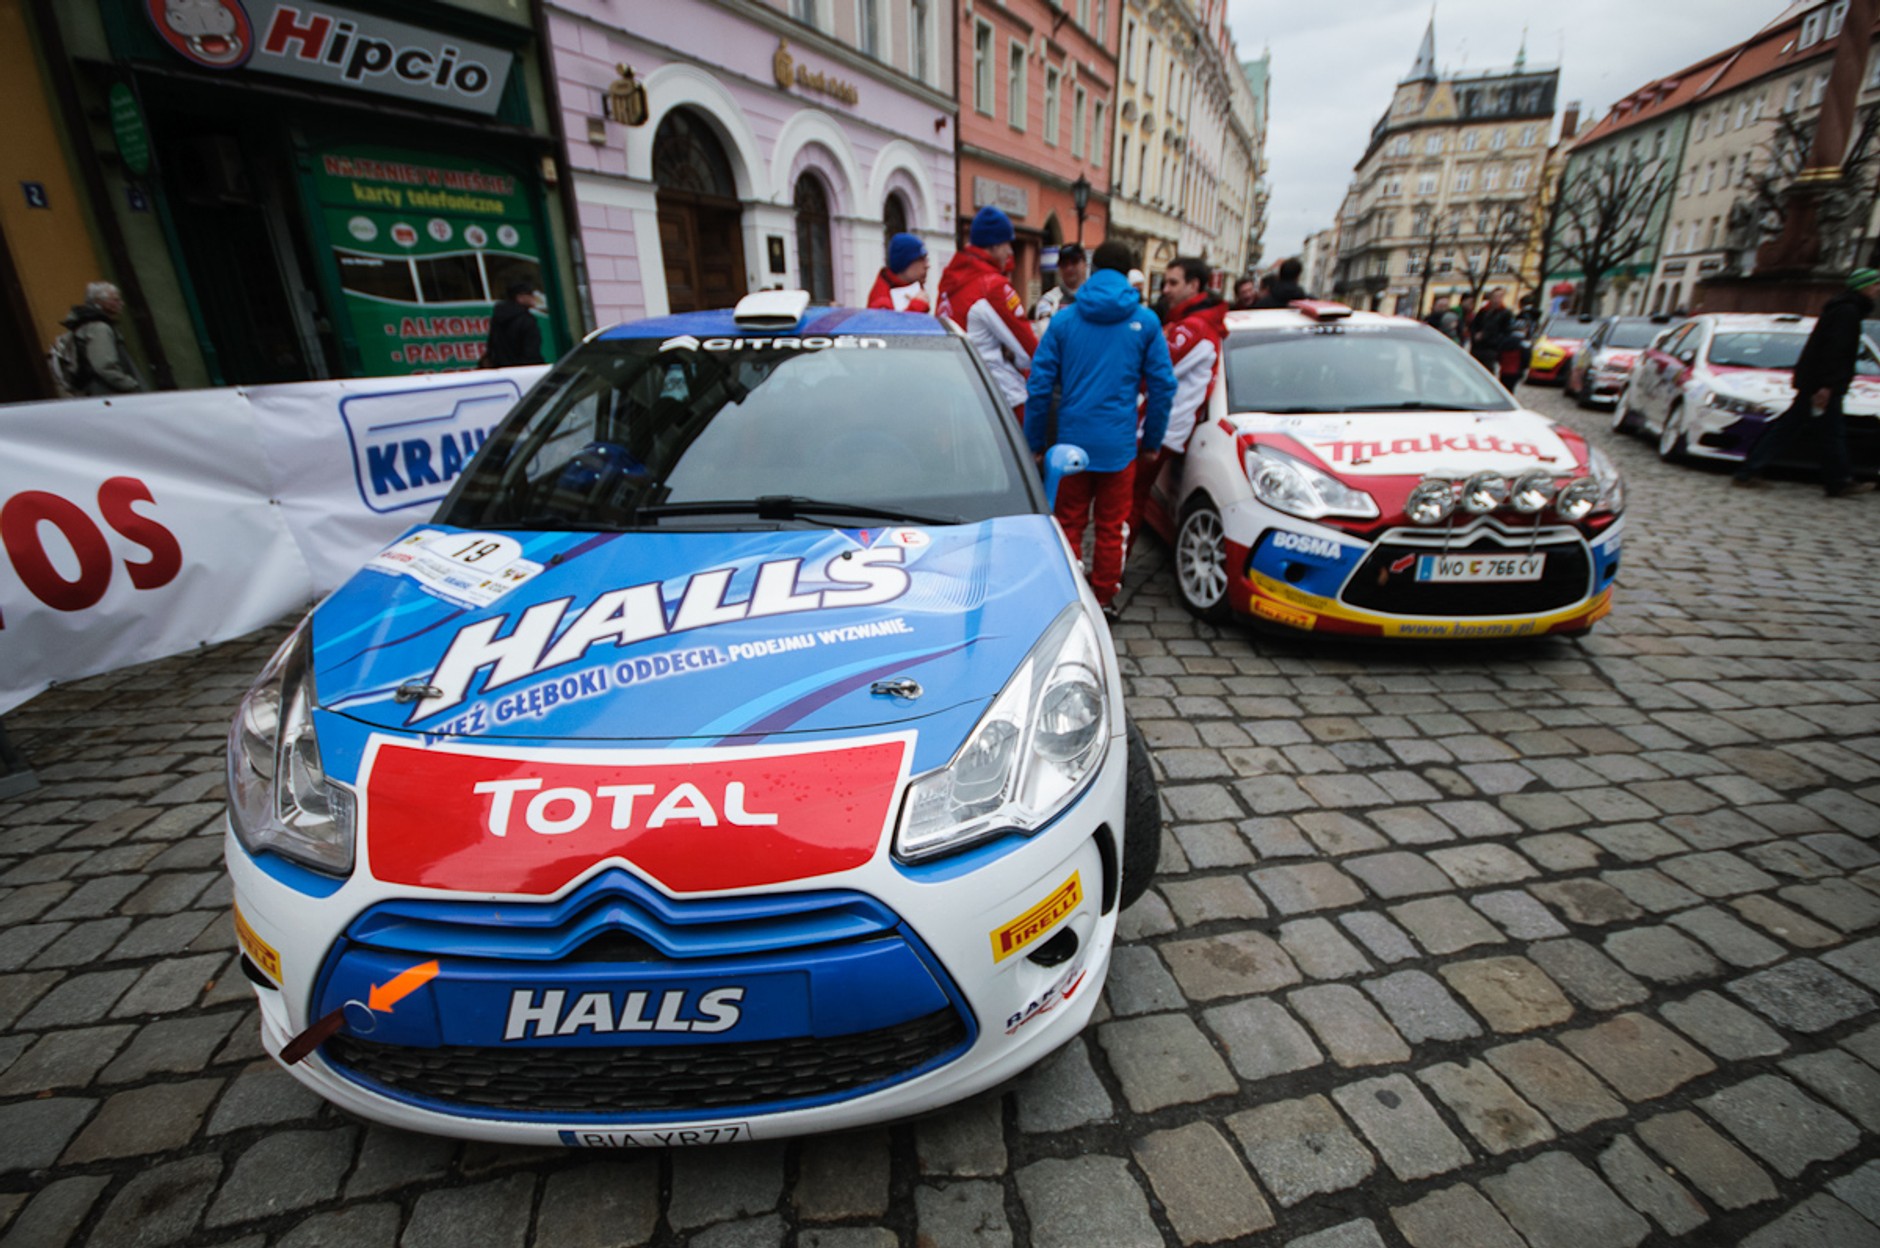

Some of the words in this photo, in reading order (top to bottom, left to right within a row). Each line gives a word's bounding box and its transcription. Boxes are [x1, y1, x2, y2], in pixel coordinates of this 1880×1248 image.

[261, 4, 492, 95] Hipcio
[352, 182, 403, 208] karty
[702, 337, 887, 351] CITROËN
[1314, 433, 1547, 462] makita
[0, 476, 182, 629] OS
[451, 539, 501, 563] 19
[1272, 531, 1341, 559] BOSMA
[402, 547, 913, 727] HALLS
[496, 667, 607, 722] GŁĘBOKI
[616, 646, 727, 688] ODDECH.
[818, 622, 914, 645] WYZWANIE.
[473, 778, 779, 837] TOTAL
[1000, 880, 1078, 954] PIRELLI
[504, 986, 746, 1040] HALLS
